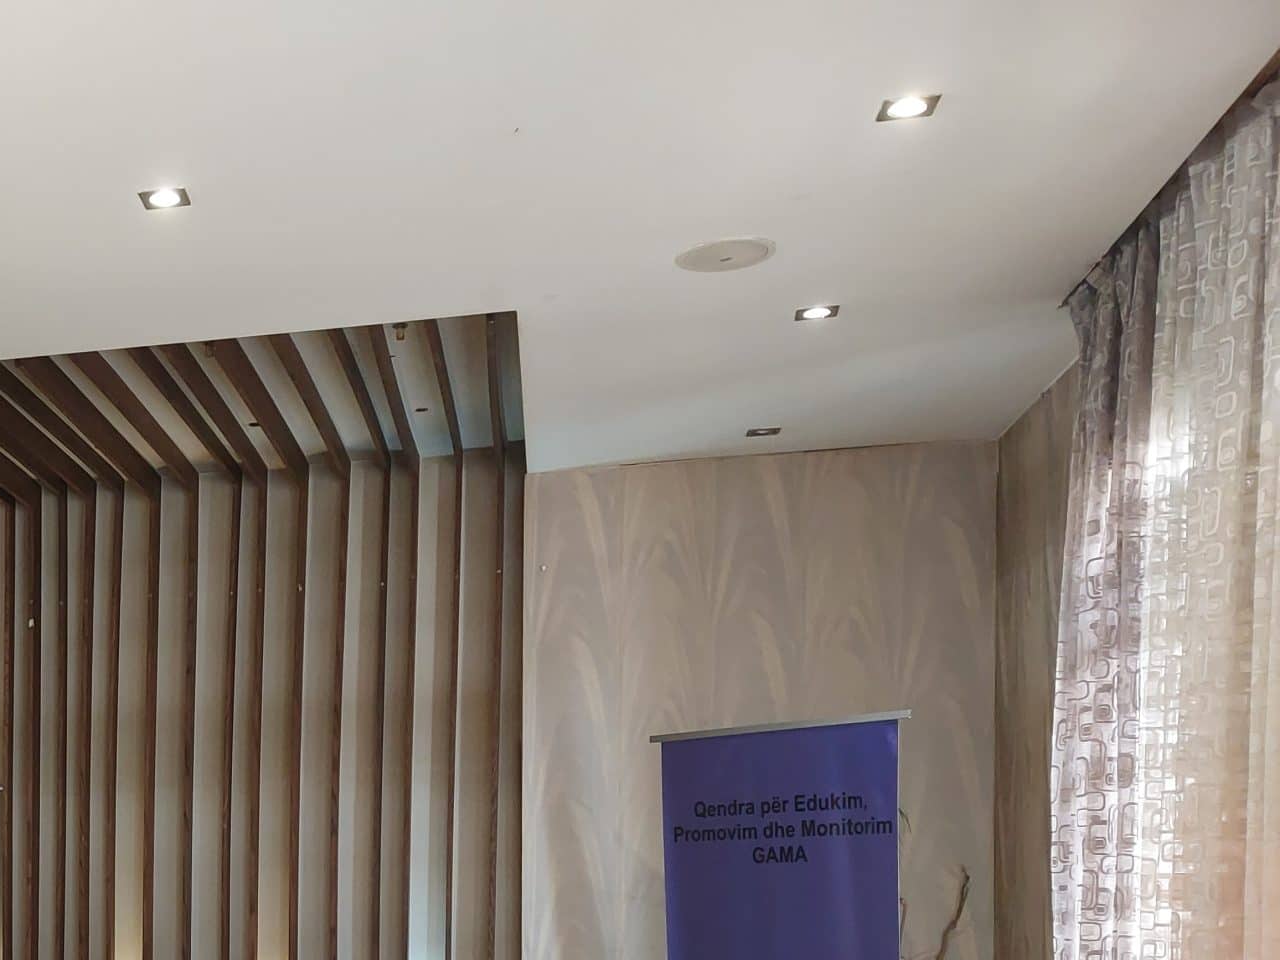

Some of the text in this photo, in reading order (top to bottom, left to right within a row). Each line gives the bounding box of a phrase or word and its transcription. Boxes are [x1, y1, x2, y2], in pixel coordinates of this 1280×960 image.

[694, 801, 755, 818] Qendra
[761, 796, 789, 817] për
[674, 817, 893, 843] Promovim dhe Monitorim
[752, 846, 808, 864] GAMA
